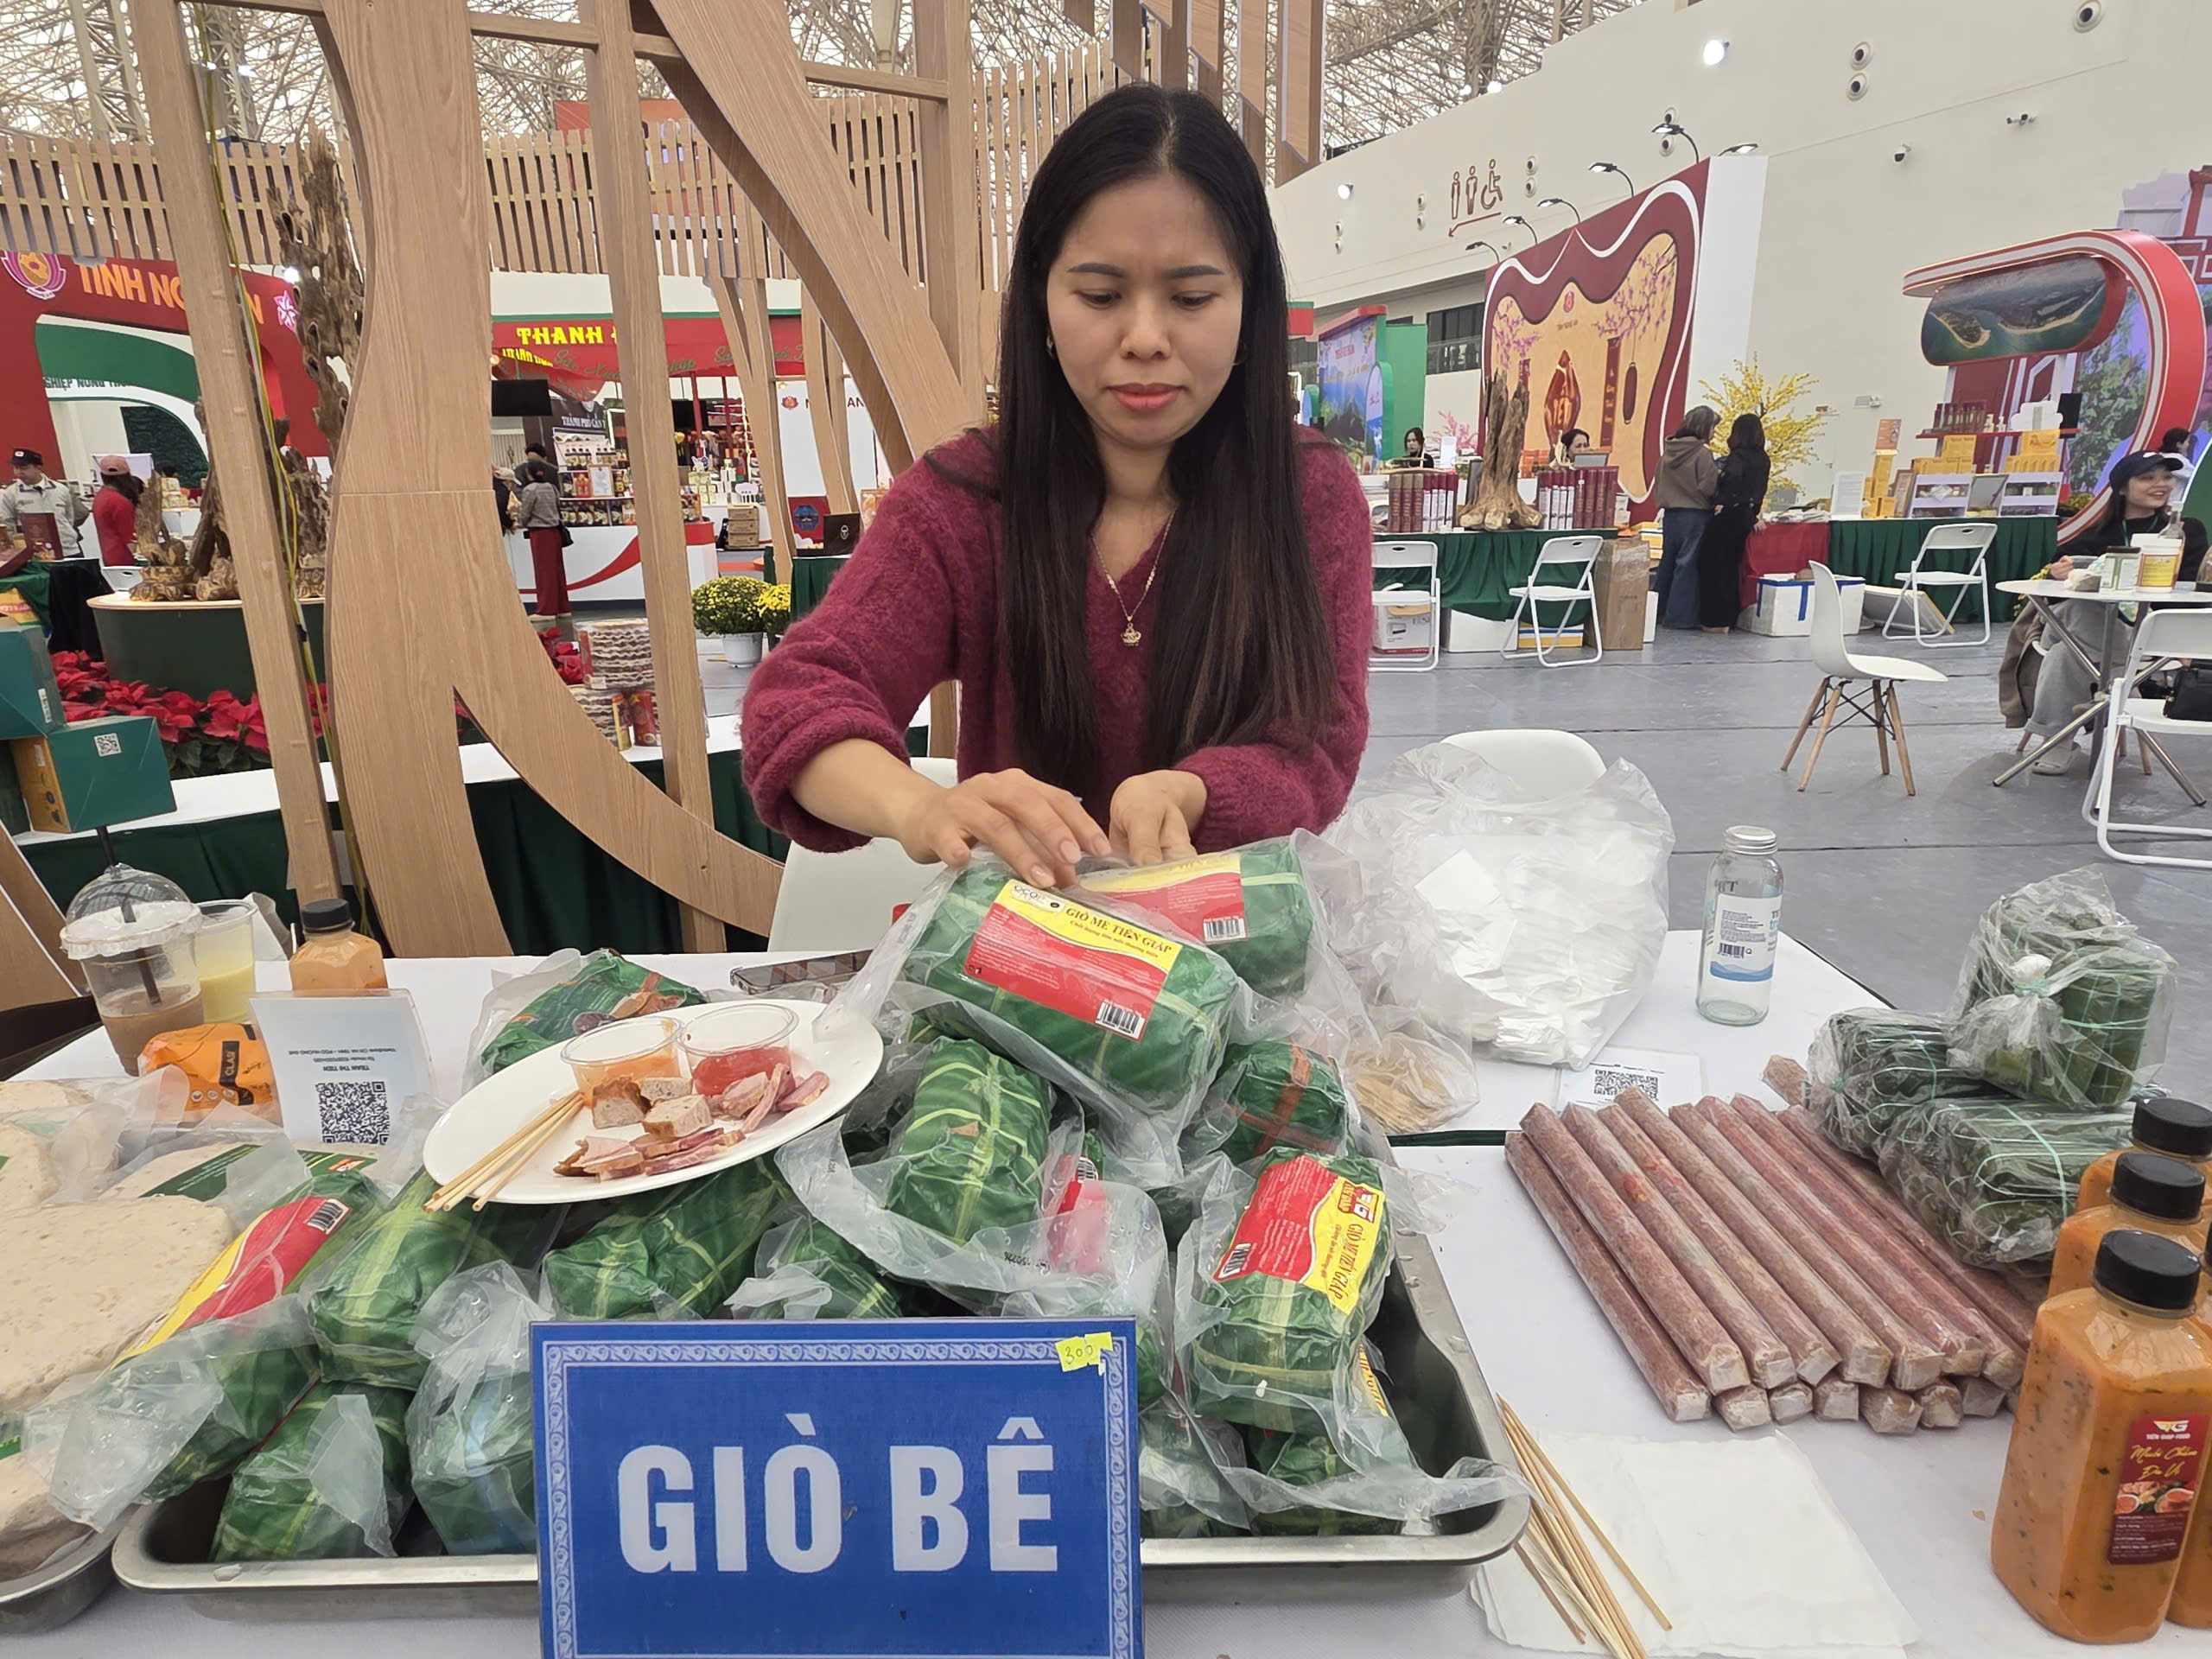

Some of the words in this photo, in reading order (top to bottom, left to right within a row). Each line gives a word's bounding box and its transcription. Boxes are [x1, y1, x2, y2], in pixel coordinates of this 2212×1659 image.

[517, 326, 603, 346] THANH
[1066, 906, 1090, 922] GIÒ
[1065, 1344, 1094, 1365] 300
[617, 1413, 842, 1573] GIÒ
[889, 1417, 1057, 1571] BÊ
